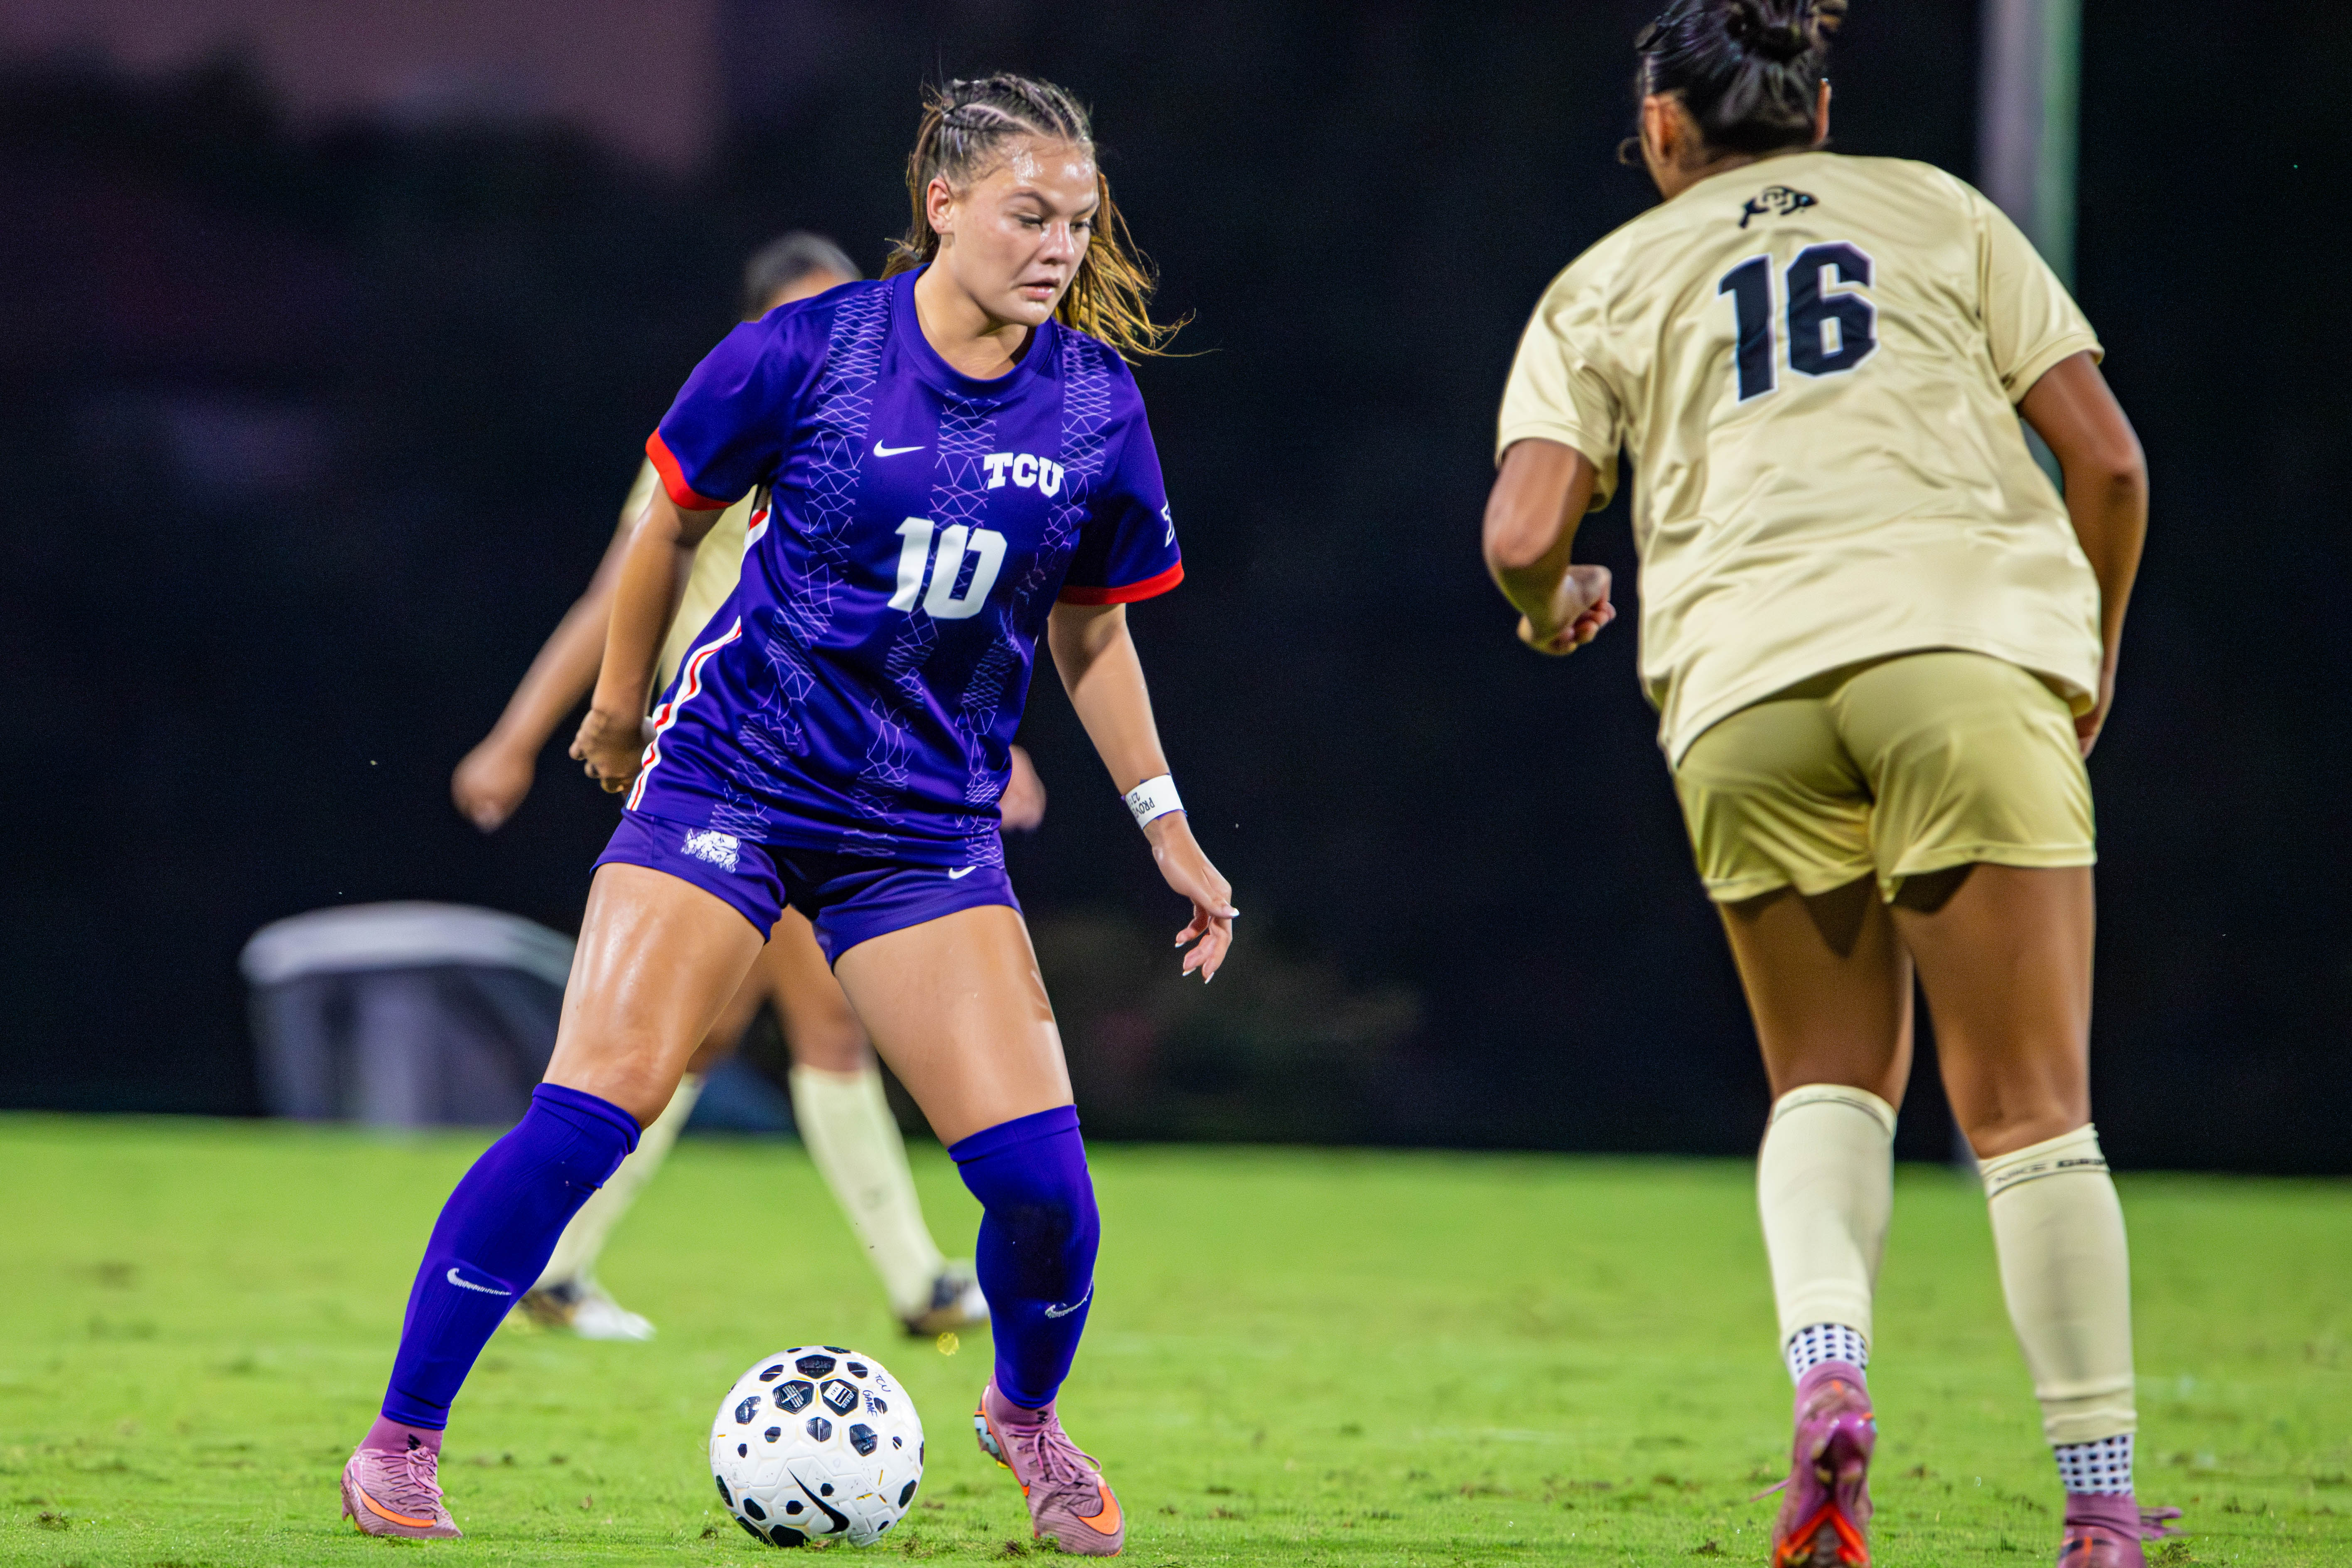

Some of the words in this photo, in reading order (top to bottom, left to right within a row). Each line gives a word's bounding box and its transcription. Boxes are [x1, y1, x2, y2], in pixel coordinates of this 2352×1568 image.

[1717, 241, 1880, 404] 16
[983, 452, 1064, 498] TCU
[887, 516, 1008, 619] 10
[831, 1387, 839, 1396] FIFA
[875, 1374, 891, 1392] TCU
[863, 1390, 877, 1418] GAME
